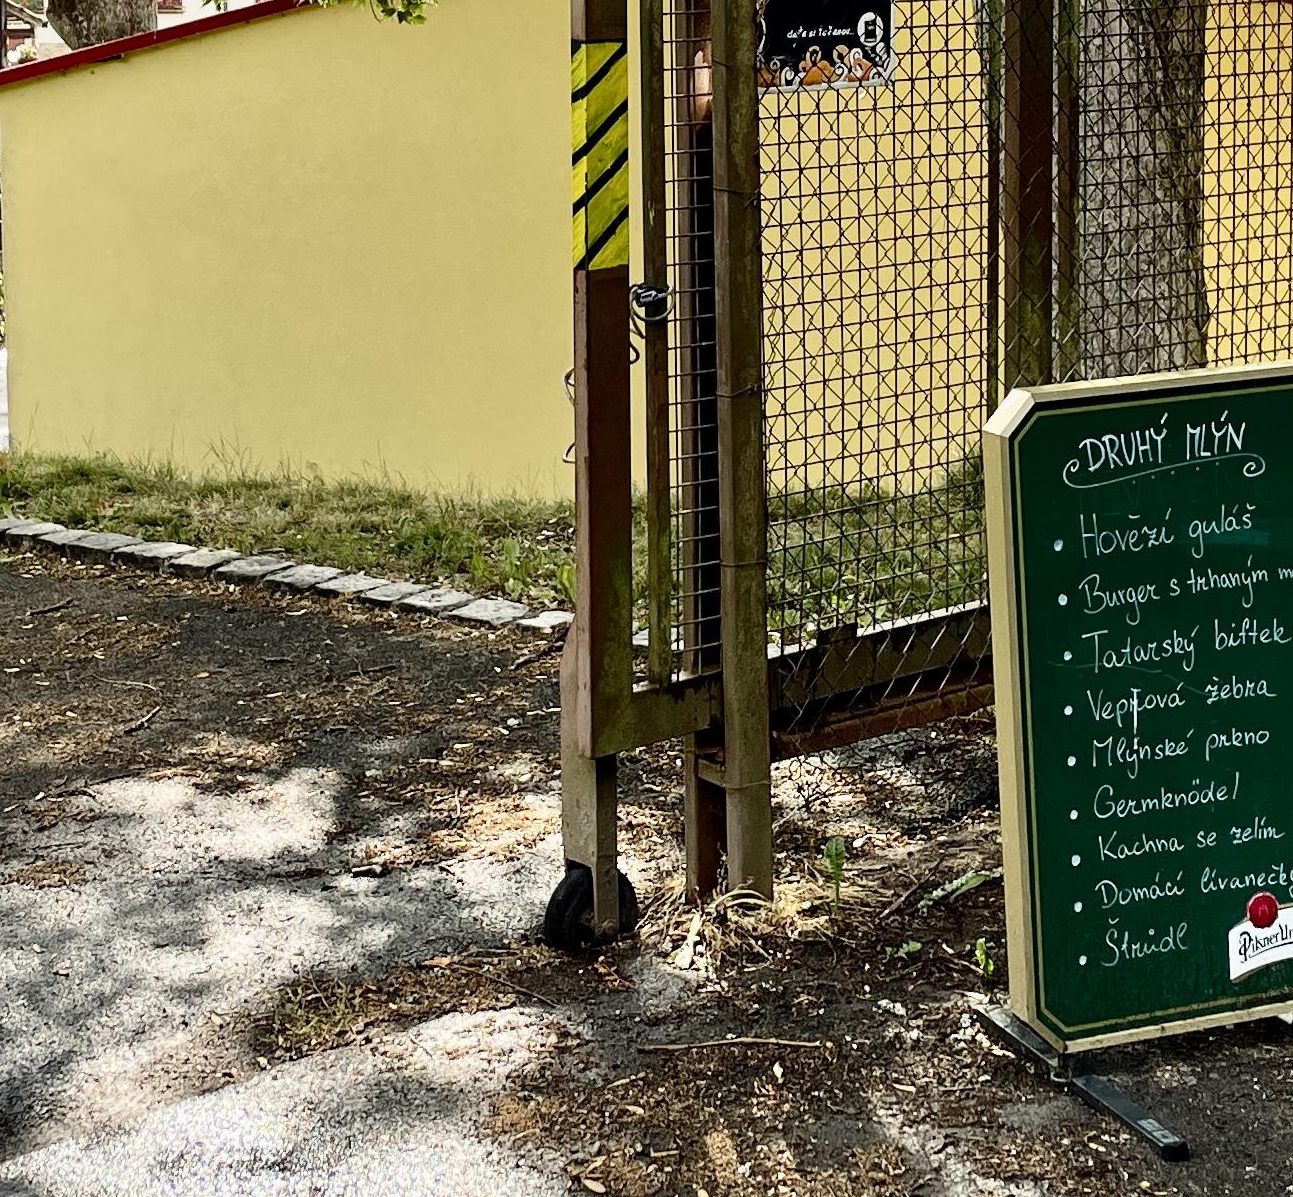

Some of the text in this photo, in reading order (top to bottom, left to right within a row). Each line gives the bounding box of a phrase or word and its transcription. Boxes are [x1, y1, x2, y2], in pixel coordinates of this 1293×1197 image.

[1078, 410, 1246, 472] DRUHÝ MLÝN
[1079, 503, 1257, 559] Hovězí guláš
[1078, 573, 1161, 626] Burger
[1169, 578, 1181, 597] s
[1187, 554, 1269, 609] trhaným
[1081, 618, 1293, 674] Tatarský biftek
[1205, 675, 1278, 705] žebra
[1092, 728, 1271, 780] Mlýnské prkno
[1093, 771, 1241, 820] Germknödel
[1098, 816, 1286, 861] Kachna se zelím
[1094, 869, 1186, 910] Domácí
